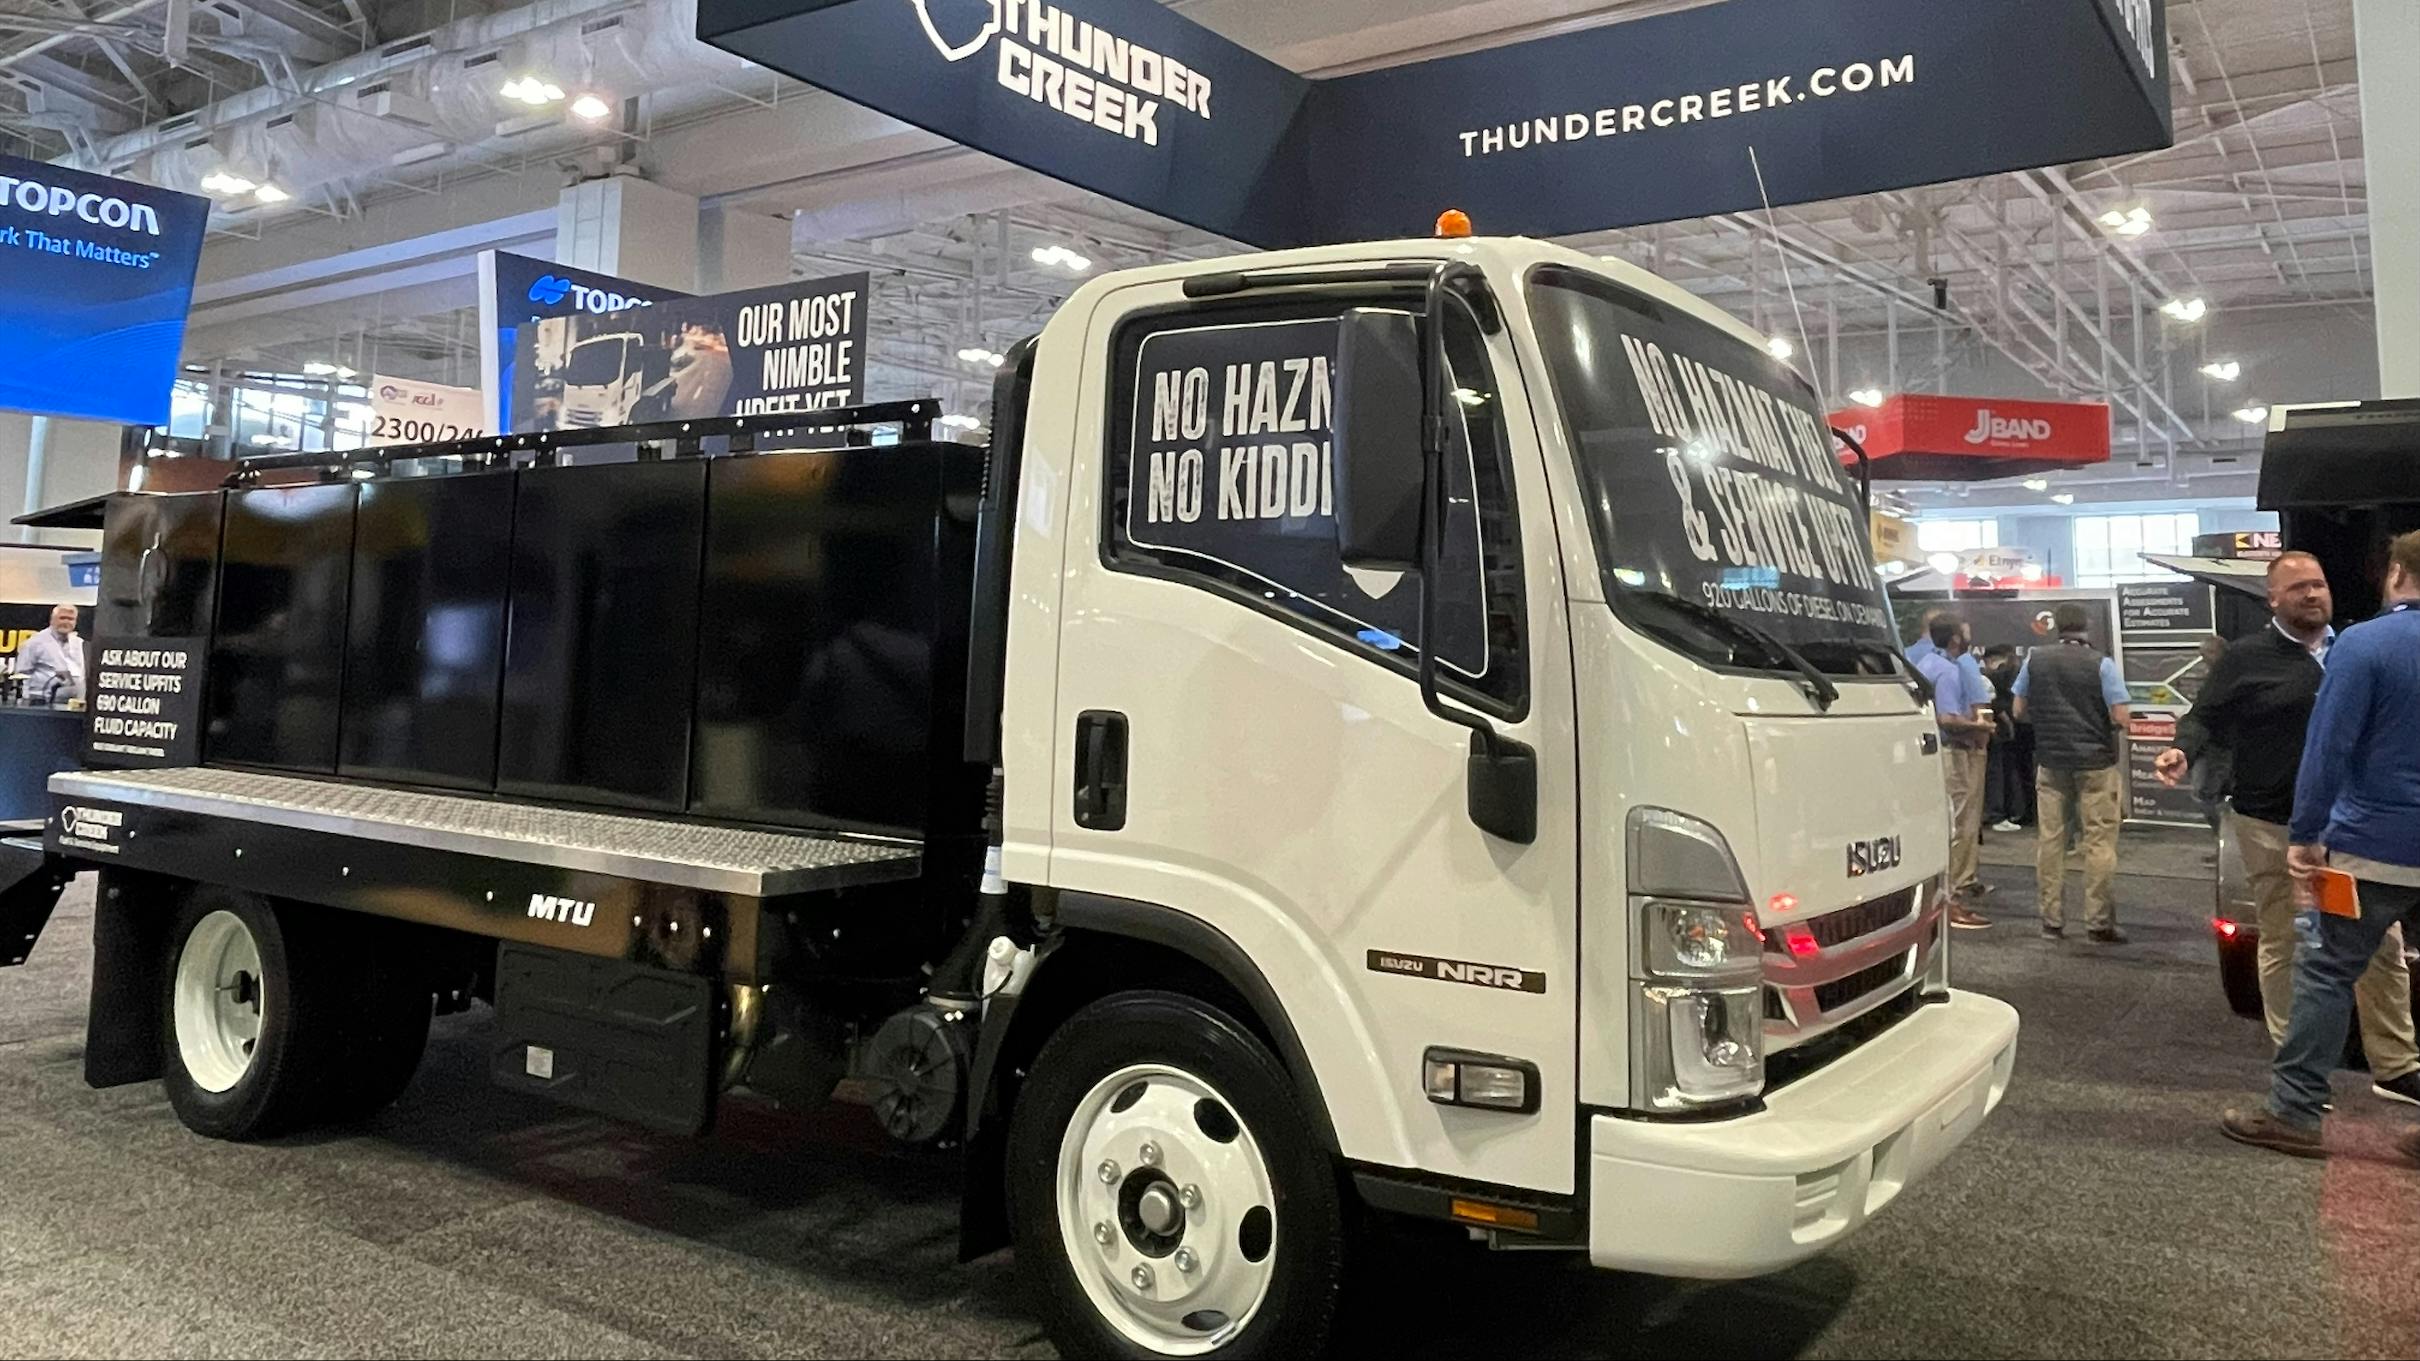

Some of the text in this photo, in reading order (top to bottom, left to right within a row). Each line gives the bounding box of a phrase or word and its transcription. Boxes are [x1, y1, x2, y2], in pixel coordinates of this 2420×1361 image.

[1001, 0, 1212, 120] THUNDER
[998, 37, 1159, 147] CREEK
[1459, 54, 1915, 157] THUNDERCREEK.COM
[0, 175, 160, 236] TOPCON
[25, 229, 71, 256] That
[738, 291, 857, 347] OUR MOST
[762, 340, 853, 391] NIMBLE
[1151, 366, 1210, 442] NO
[1620, 333, 1844, 495] NO HAZMAT FUEL
[1148, 448, 1204, 523] NO
[1666, 448, 1874, 591] & SERVICE UPFIT
[1702, 581, 1733, 609] 920
[1732, 586, 1789, 615] GALLONS
[1788, 591, 1804, 616] OF
[98, 672, 182, 694] SERVICE UPFITS
[101, 649, 188, 670] ASK ABOUT OUR
[94, 716, 178, 740] FLUID CAPACITY
[117, 695, 160, 715] GALLON
[1846, 834, 1901, 879] ISUZU
[527, 893, 596, 927] MTU
[1380, 956, 1523, 990] ISUZU NRR
